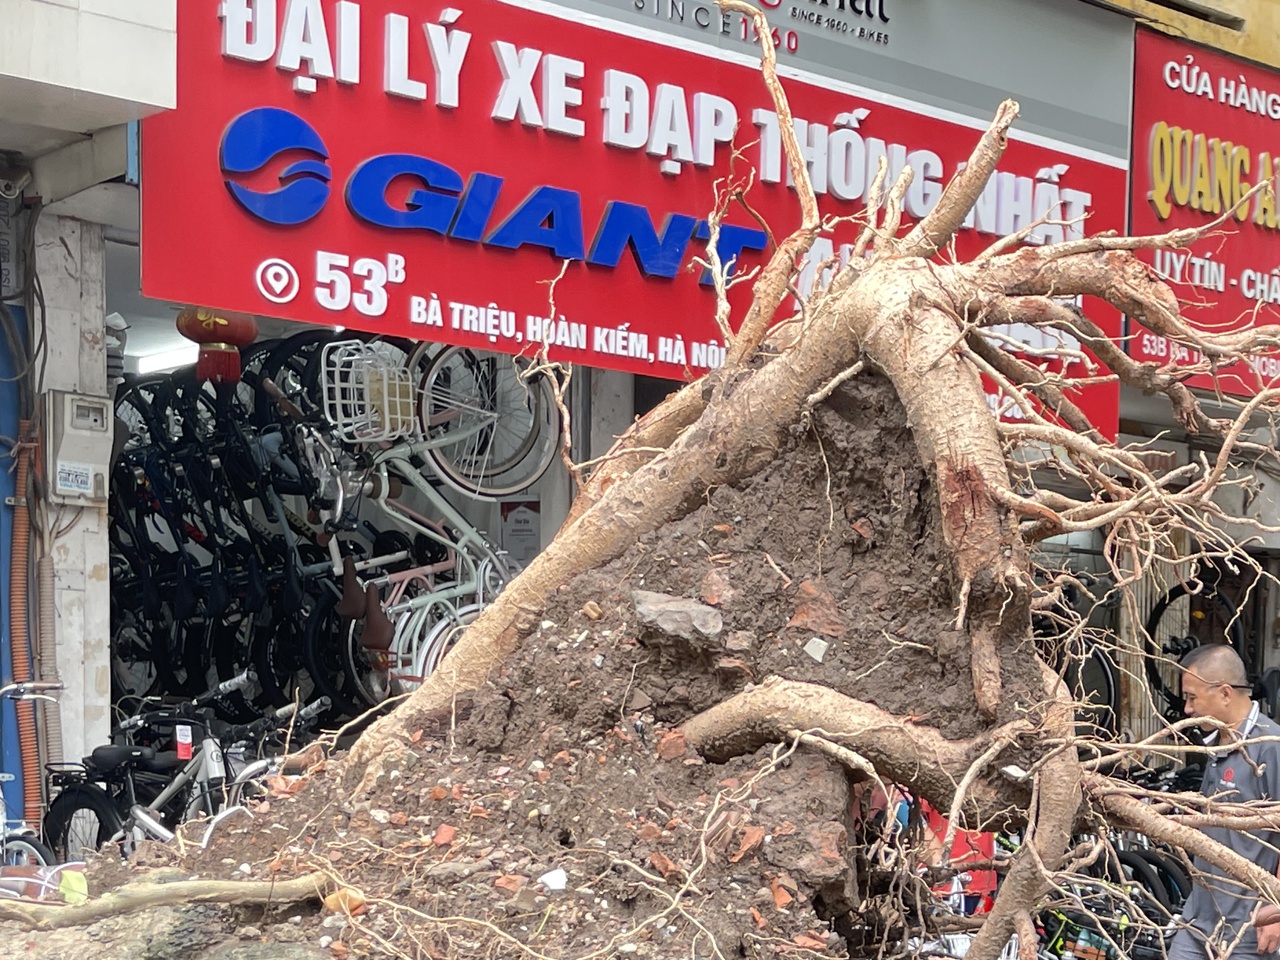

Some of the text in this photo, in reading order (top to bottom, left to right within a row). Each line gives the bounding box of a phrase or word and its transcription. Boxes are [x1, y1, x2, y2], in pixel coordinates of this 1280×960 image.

[790, 7, 823, 26] SINCE
[824, 17, 848, 33] 1960
[858, 26, 890, 46] BIKES
[217, 0, 360, 93] ĐẠI
[382, 7, 472, 110] LÝ
[491, 39, 586, 138] XE
[600, 68, 741, 175] ĐẠP
[752, 107, 944, 220] THỐNG
[1163, 54, 1215, 100] CỬA
[1146, 120, 1252, 224] QUANG
[344, 152, 769, 288] GIANT
[1154, 248, 1187, 283] UY
[1190, 252, 1226, 293] TÍN
[314, 251, 406, 318] 53B
[410, 292, 444, 327] BÀ
[449, 301, 523, 343] TRIỆU,
[526, 314, 588, 350] HOÀN
[593, 321, 656, 364] KIẾM,
[657, 333, 688, 367] HÀ
[1142, 333, 1168, 358] 53B
